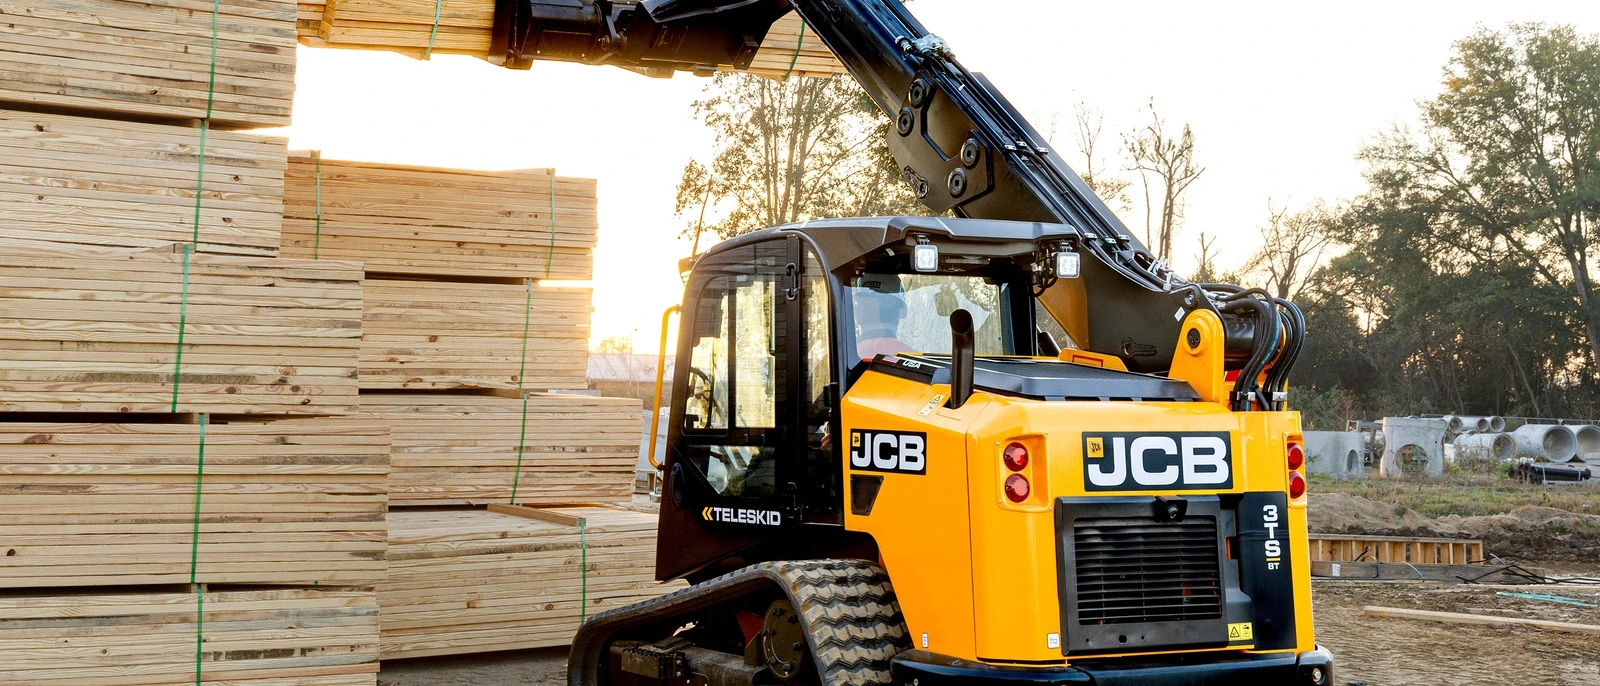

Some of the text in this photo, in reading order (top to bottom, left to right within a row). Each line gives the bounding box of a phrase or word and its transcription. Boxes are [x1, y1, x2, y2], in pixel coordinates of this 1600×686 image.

[903, 360, 920, 369] USA
[852, 432, 925, 471] JCB
[1087, 436, 1230, 486] JCB
[713, 506, 781, 526] TELESKID
[1263, 504, 1281, 557] 3TS
